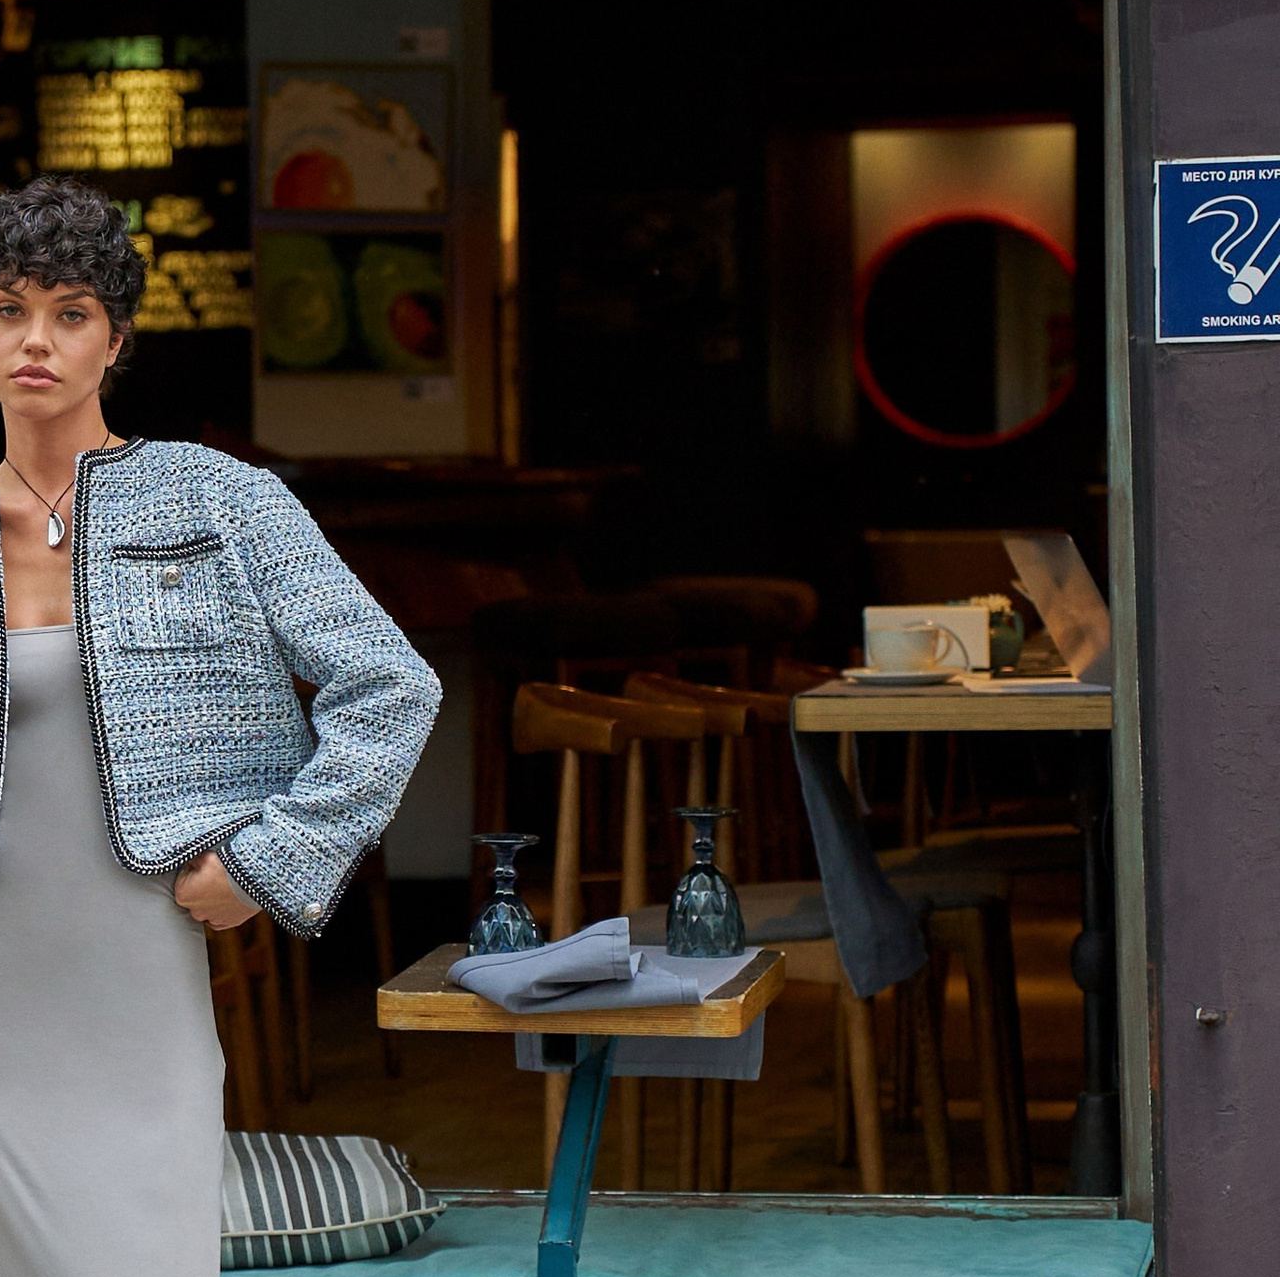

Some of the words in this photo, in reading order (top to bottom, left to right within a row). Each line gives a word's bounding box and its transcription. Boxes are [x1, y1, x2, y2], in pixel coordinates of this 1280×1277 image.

[1182, 171, 1226, 182] МЕСТО
[1228, 169, 1255, 182] ДЛЯ
[1202, 315, 1260, 327] SMOKING
